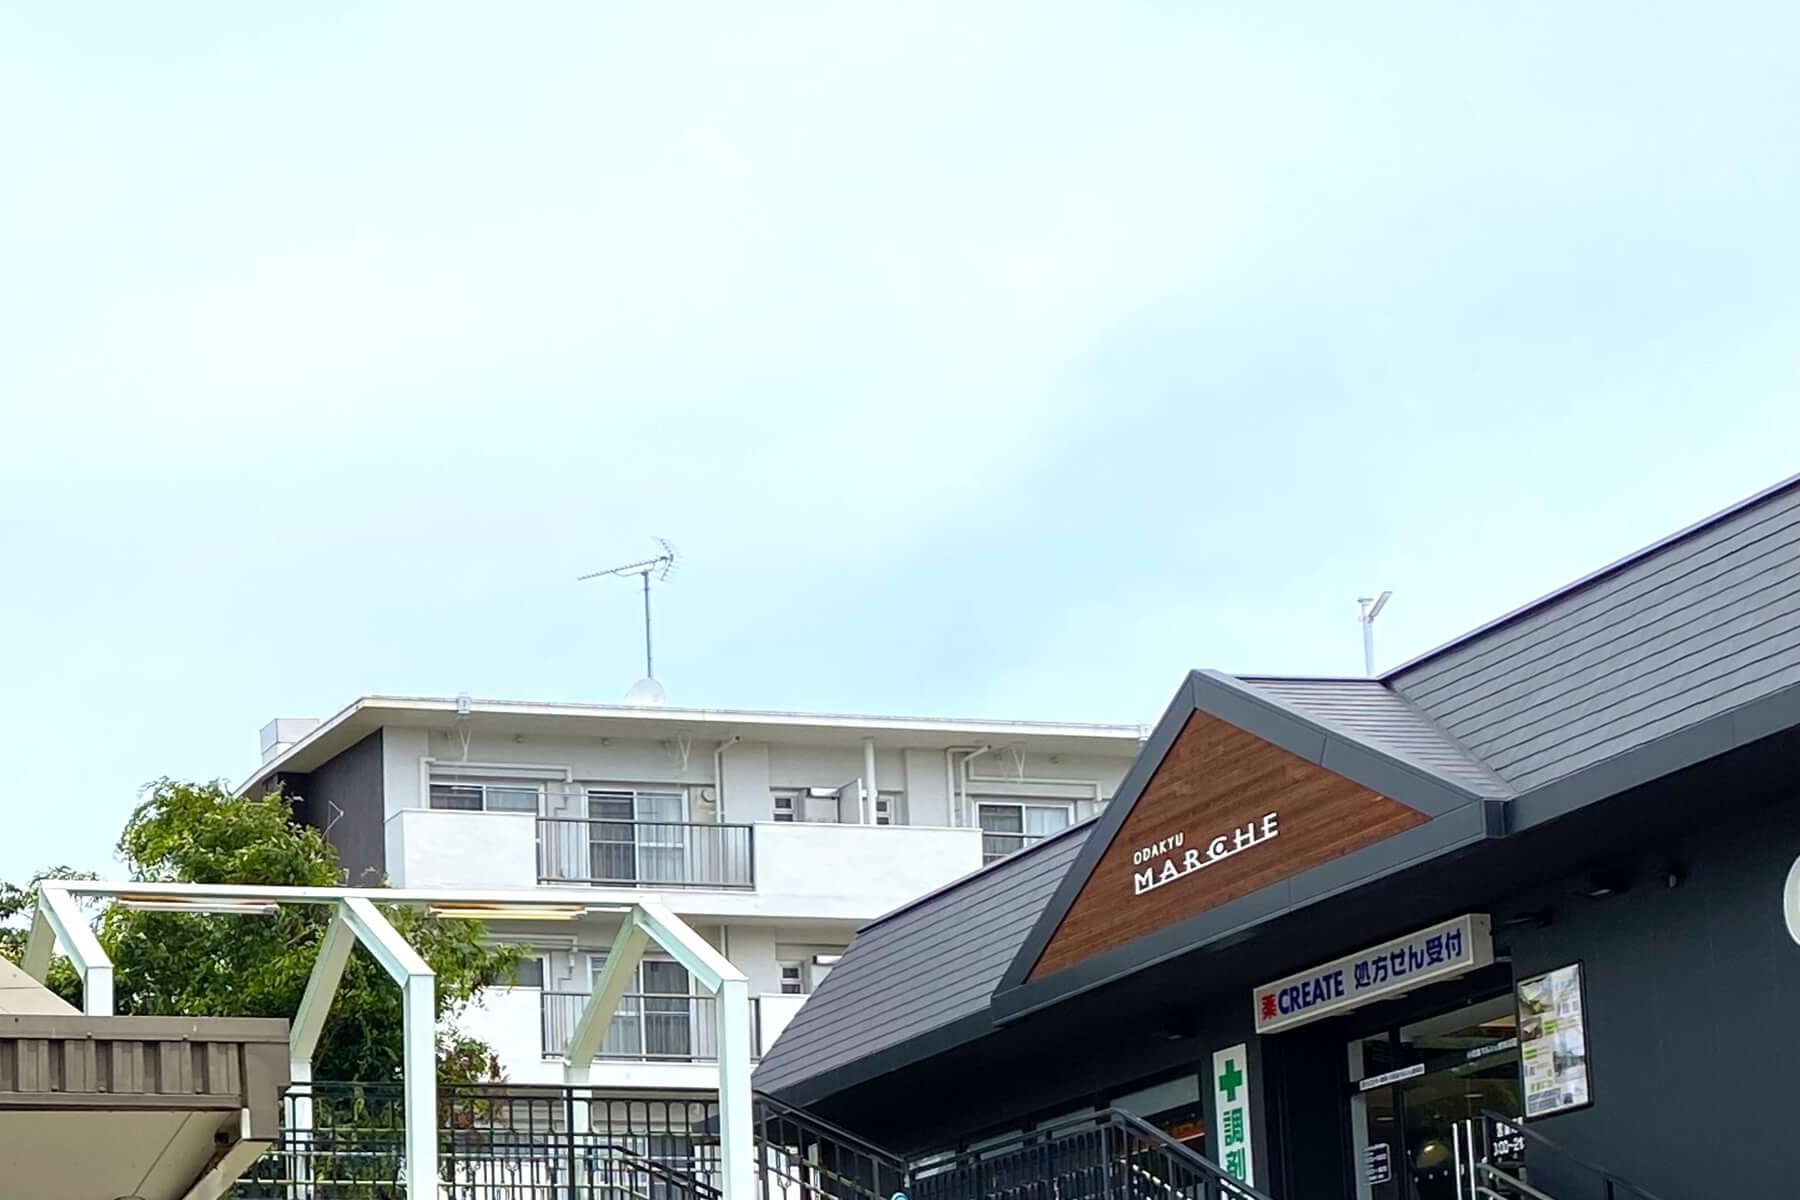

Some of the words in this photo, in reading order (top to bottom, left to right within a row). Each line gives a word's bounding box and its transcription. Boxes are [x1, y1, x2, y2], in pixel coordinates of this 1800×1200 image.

[1133, 833, 1185, 866] ODAKYU
[1133, 812, 1280, 895] MARCHE
[1278, 970, 1344, 1014] CREATE
[1354, 930, 1463, 988] 処方せん受付
